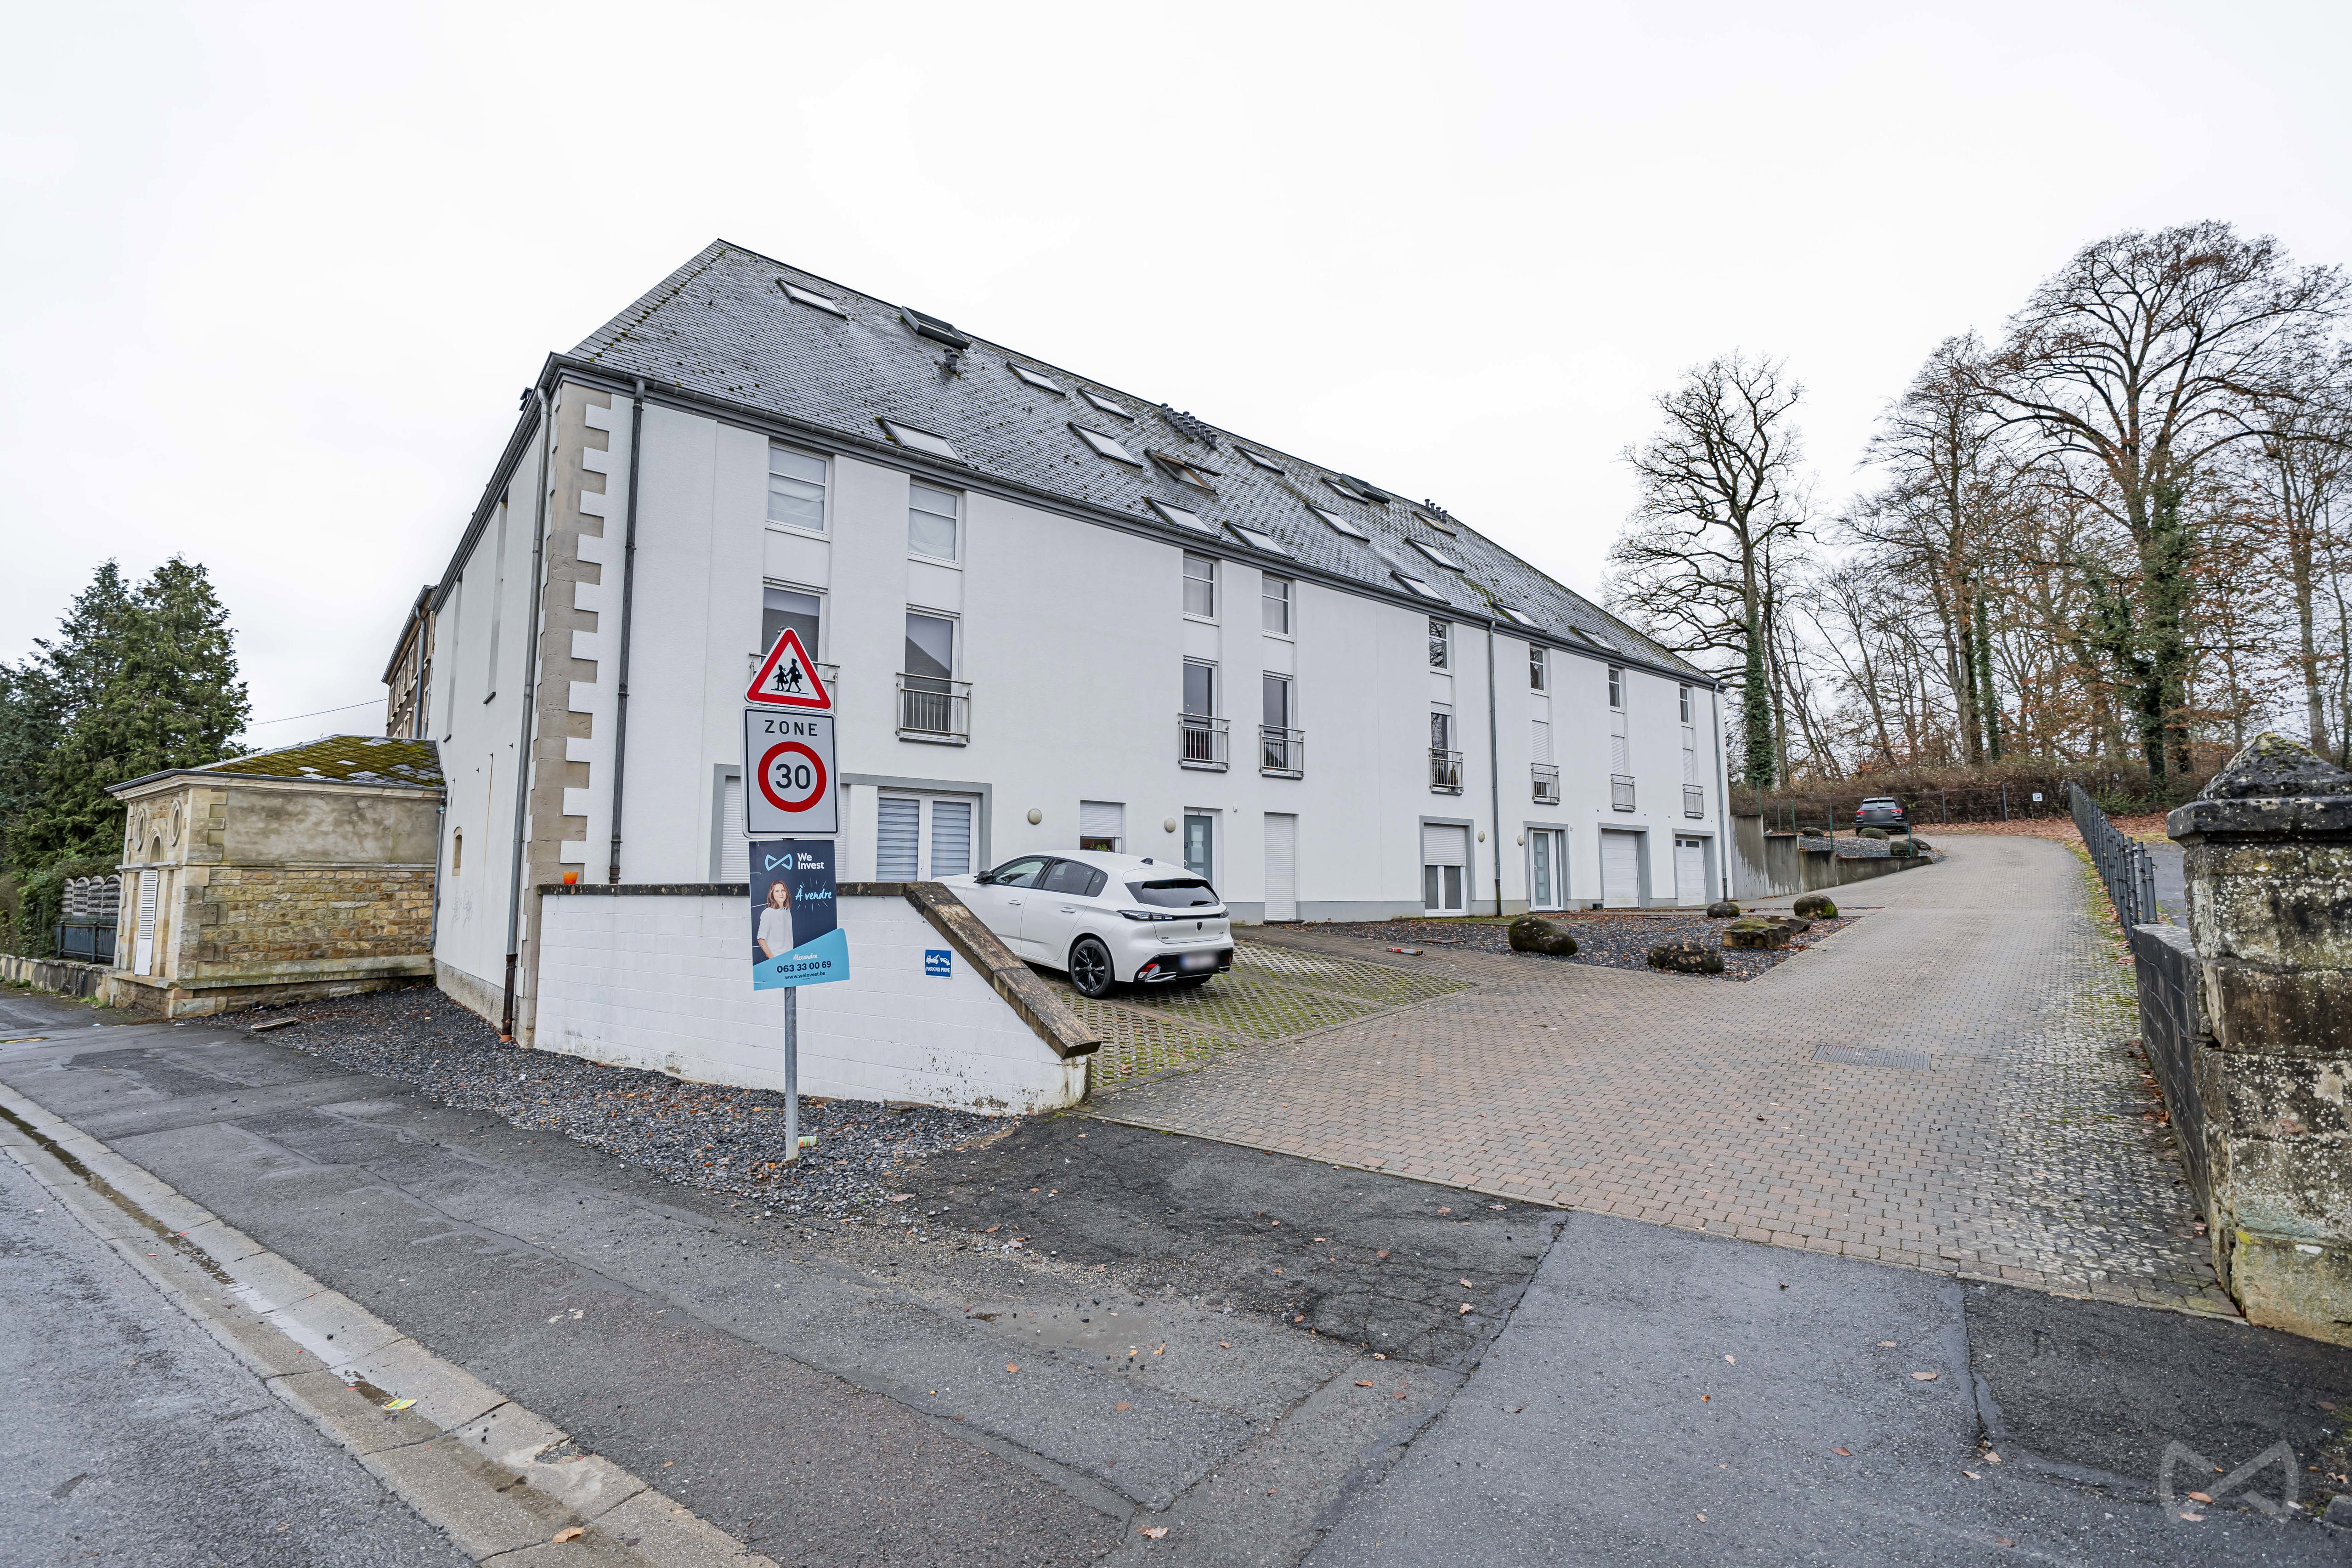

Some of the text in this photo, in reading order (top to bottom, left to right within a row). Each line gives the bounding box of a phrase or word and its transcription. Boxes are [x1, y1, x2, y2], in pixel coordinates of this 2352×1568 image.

[765, 719, 817, 736] ZONE
[775, 764, 810, 789] 30
[795, 885, 832, 901] À vendre
[777, 964, 794, 973] 063
[797, 963, 807, 971] 33
[809, 962, 820, 970] 00
[785, 971, 825, 979] www.weinvest.be
